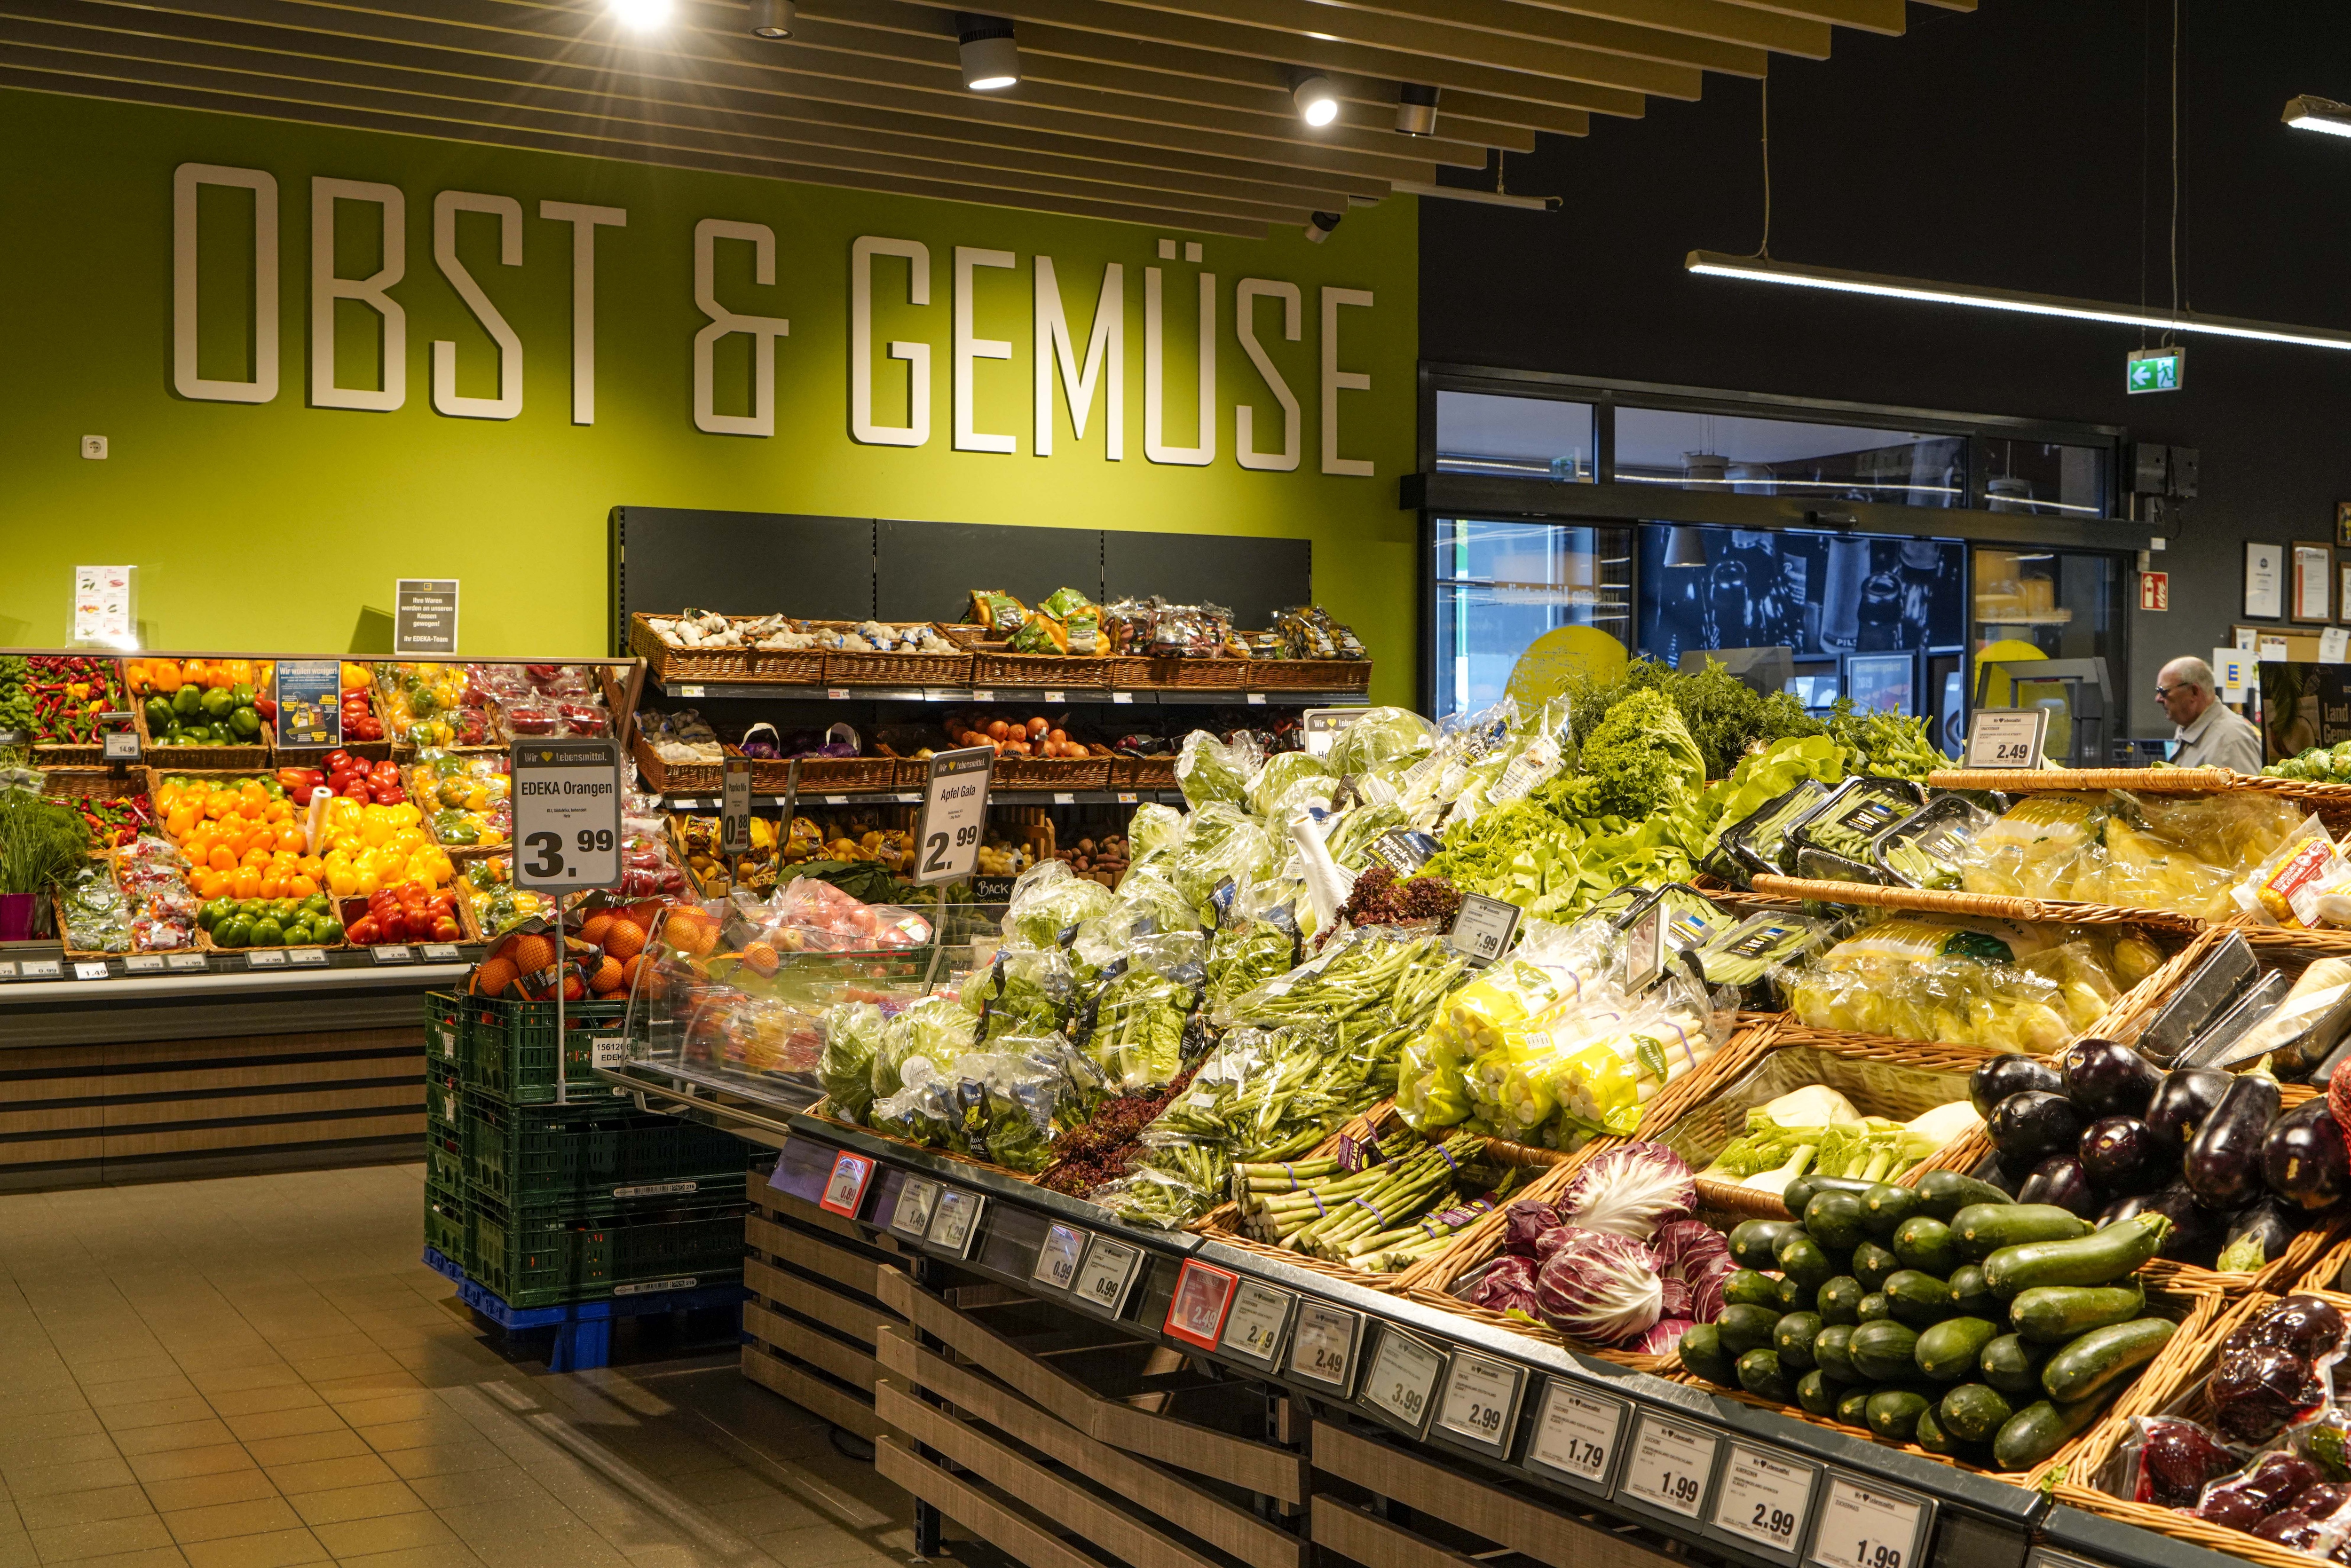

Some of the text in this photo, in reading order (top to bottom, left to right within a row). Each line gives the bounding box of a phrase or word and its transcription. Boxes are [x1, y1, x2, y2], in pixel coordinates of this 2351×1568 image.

[174, 163, 1374, 476] OBST & GEMÜSE
[312, 667, 337, 676] weniger!
[2324, 703, 2348, 723] Land
[524, 752, 607, 762] Wir Lebensmittel.
[1997, 744, 2028, 759] 2.49
[521, 781, 612, 797] EDEKA Orangen
[941, 785, 976, 803] Apfel Gala
[524, 829, 613, 877] 3.99
[922, 825, 977, 874] 2.99
[1404, 833, 1425, 854] EDEKA
[977, 881, 1009, 897] BACK
[840, 1185, 857, 1202] 0.89
[910, 1210, 926, 1228] 1.49
[946, 1224, 964, 1241] 1.29
[1053, 1261, 1073, 1280] 0.99
[1197, 1273, 1220, 1286] WERBUNG
[1096, 1277, 1119, 1298] 0.99
[1192, 1306, 1217, 1329] 2.49
[1315, 1348, 1343, 1372] 2.49
[1392, 1383, 1422, 1414] 3.99
[1468, 1404, 1501, 1431] 2.99
[1569, 1439, 1603, 1468] 1.79
[1662, 1471, 1698, 1503] 1.99
[1752, 1504, 1795, 1536] 2.99
[1858, 1539, 1901, 1568] 1.99
